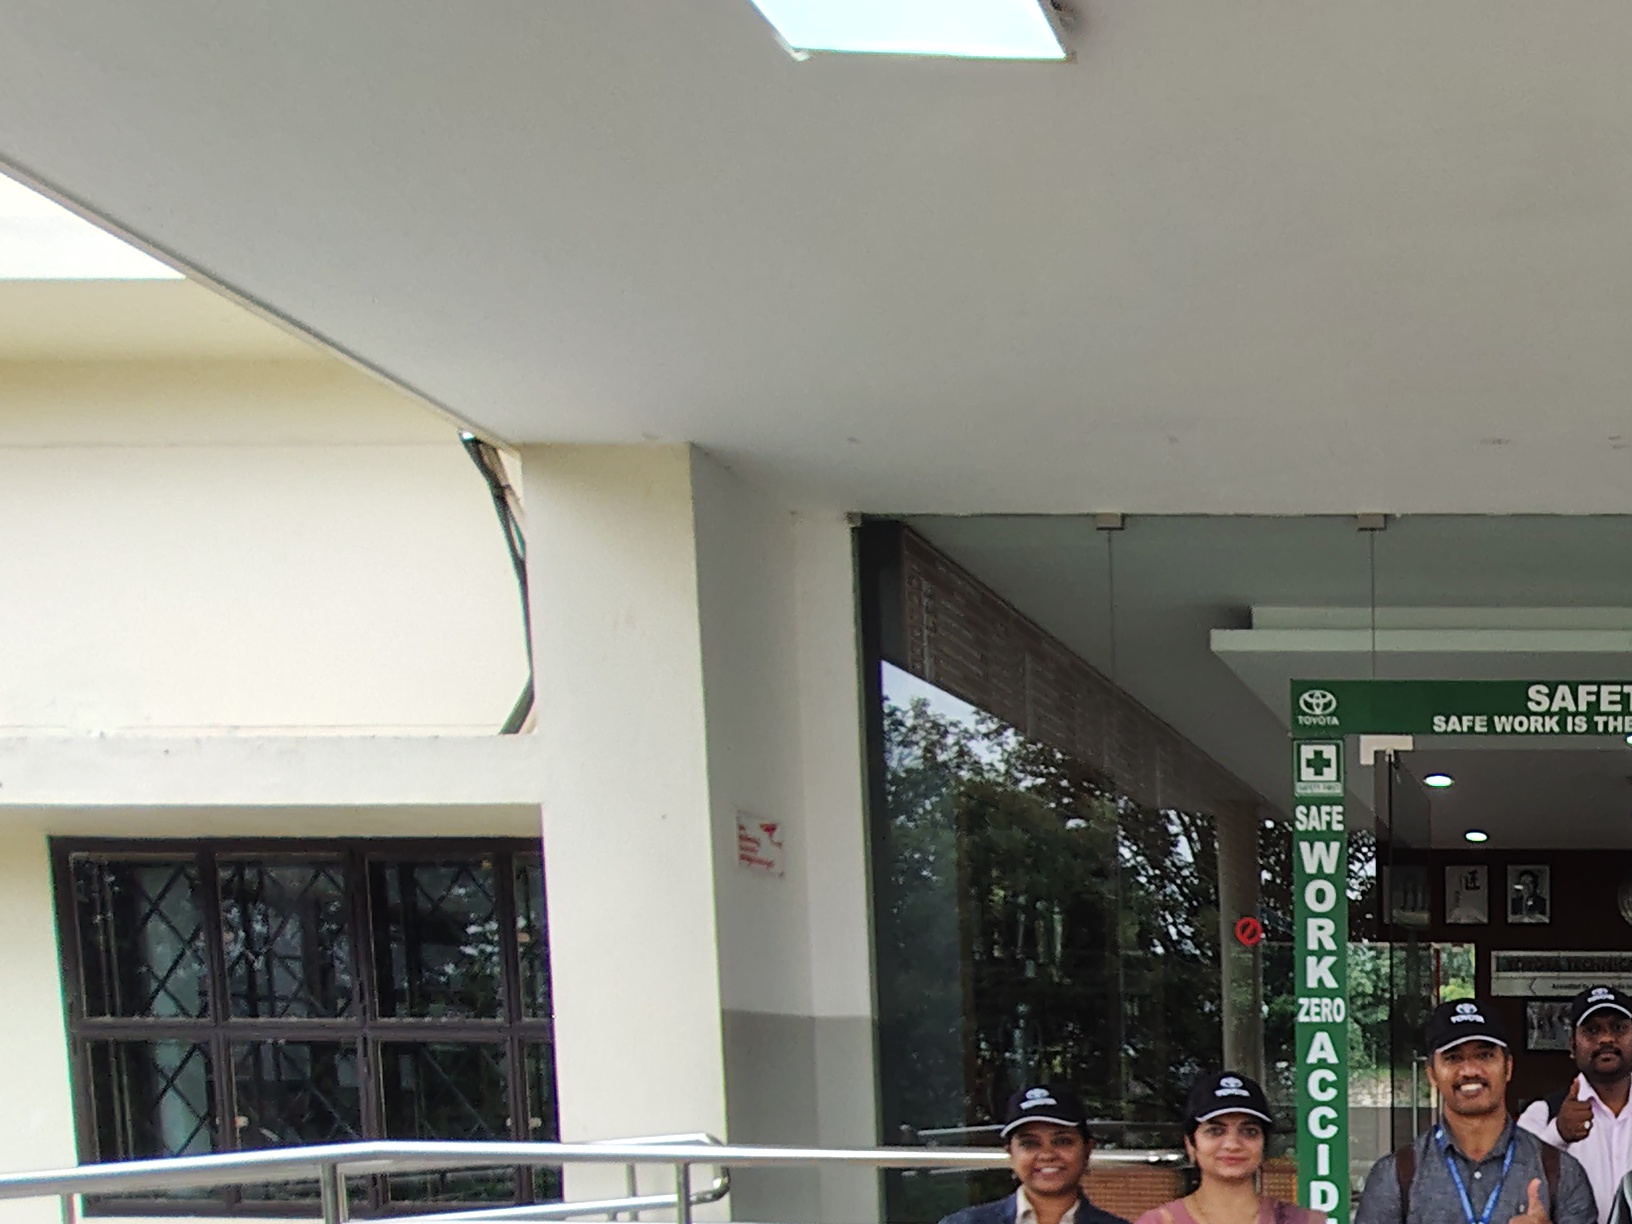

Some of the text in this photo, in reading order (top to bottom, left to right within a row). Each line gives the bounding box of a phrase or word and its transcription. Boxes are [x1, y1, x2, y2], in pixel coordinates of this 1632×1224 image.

[1298, 715, 1340, 726] TOYOTA
[1432, 715, 1488, 733] SAFE
[1493, 715, 1560, 733] WORK
[1566, 715, 1588, 733] IS
[1295, 805, 1345, 989] SAFE WORK
[1297, 997, 1346, 1023] ZERO
